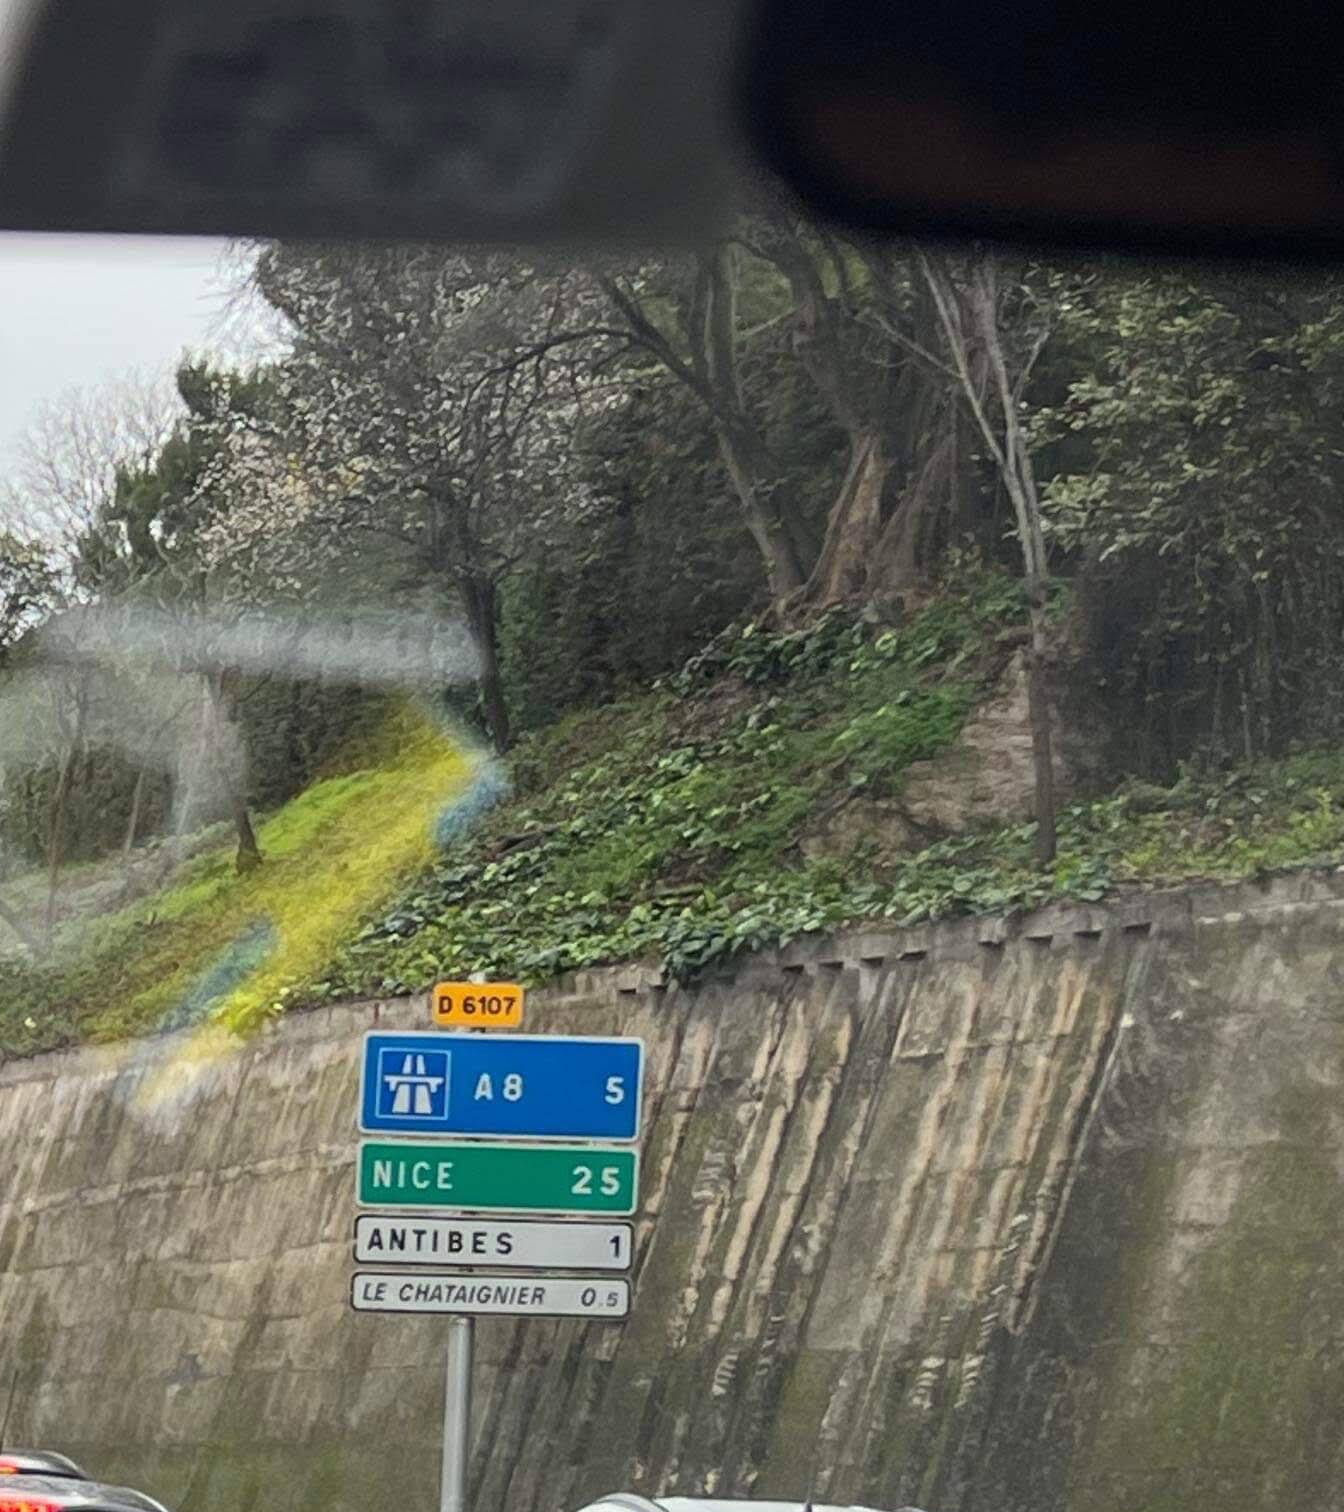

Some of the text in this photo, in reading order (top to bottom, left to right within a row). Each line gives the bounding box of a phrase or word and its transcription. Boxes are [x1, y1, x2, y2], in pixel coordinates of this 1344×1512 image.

[439, 996, 516, 1016] D 6107
[474, 1073, 625, 1105] A8 5
[373, 1161, 621, 1196] NICE 25
[367, 1228, 622, 1260] ANTIBES 1
[363, 1282, 388, 1302] LE
[399, 1283, 547, 1307] CHATAIGNIER
